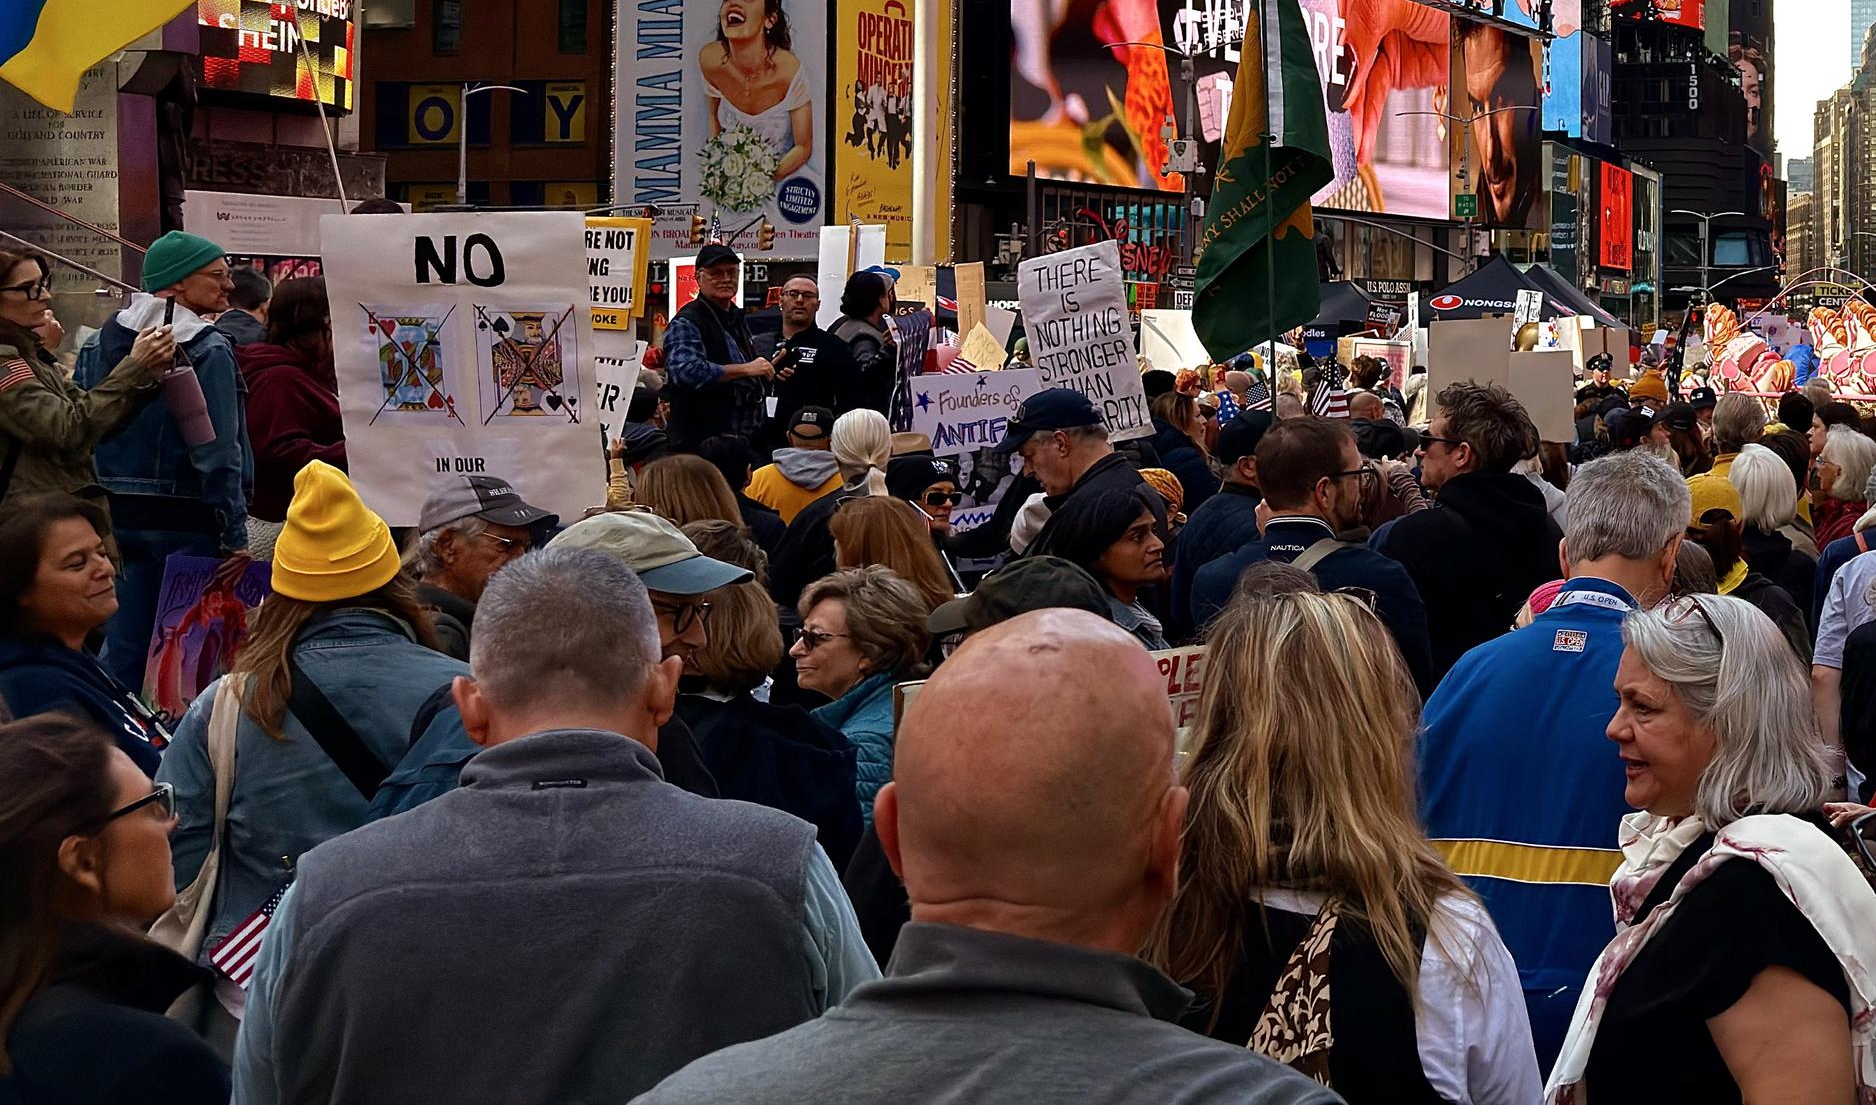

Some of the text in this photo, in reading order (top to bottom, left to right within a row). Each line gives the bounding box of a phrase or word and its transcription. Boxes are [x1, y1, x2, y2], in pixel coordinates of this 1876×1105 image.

[1687, 63, 1698, 110] 1500
[415, 95, 584, 141] O Y
[634, 69, 683, 203] MAMMA
[784, 195, 814, 206] LIMITED
[785, 186, 816, 199] STRICTLY
[779, 201, 817, 215] ENGAGEMENT
[1220, 189, 1265, 229] SHALL
[605, 231, 634, 250] NOT
[414, 233, 505, 287] NO
[1034, 257, 1102, 293] THERE
[602, 286, 632, 305] YOU!
[1378, 281, 1394, 293] POLO
[1061, 291, 1080, 313] IS
[1034, 306, 1122, 352] NOTHING
[1037, 339, 1129, 382] STRONGER
[939, 387, 1001, 415] Founders
[436, 457, 485, 473] IN OUR
[1270, 544, 1305, 552] NAUTICA
[1583, 594, 1617, 606] U.S. OPEN
